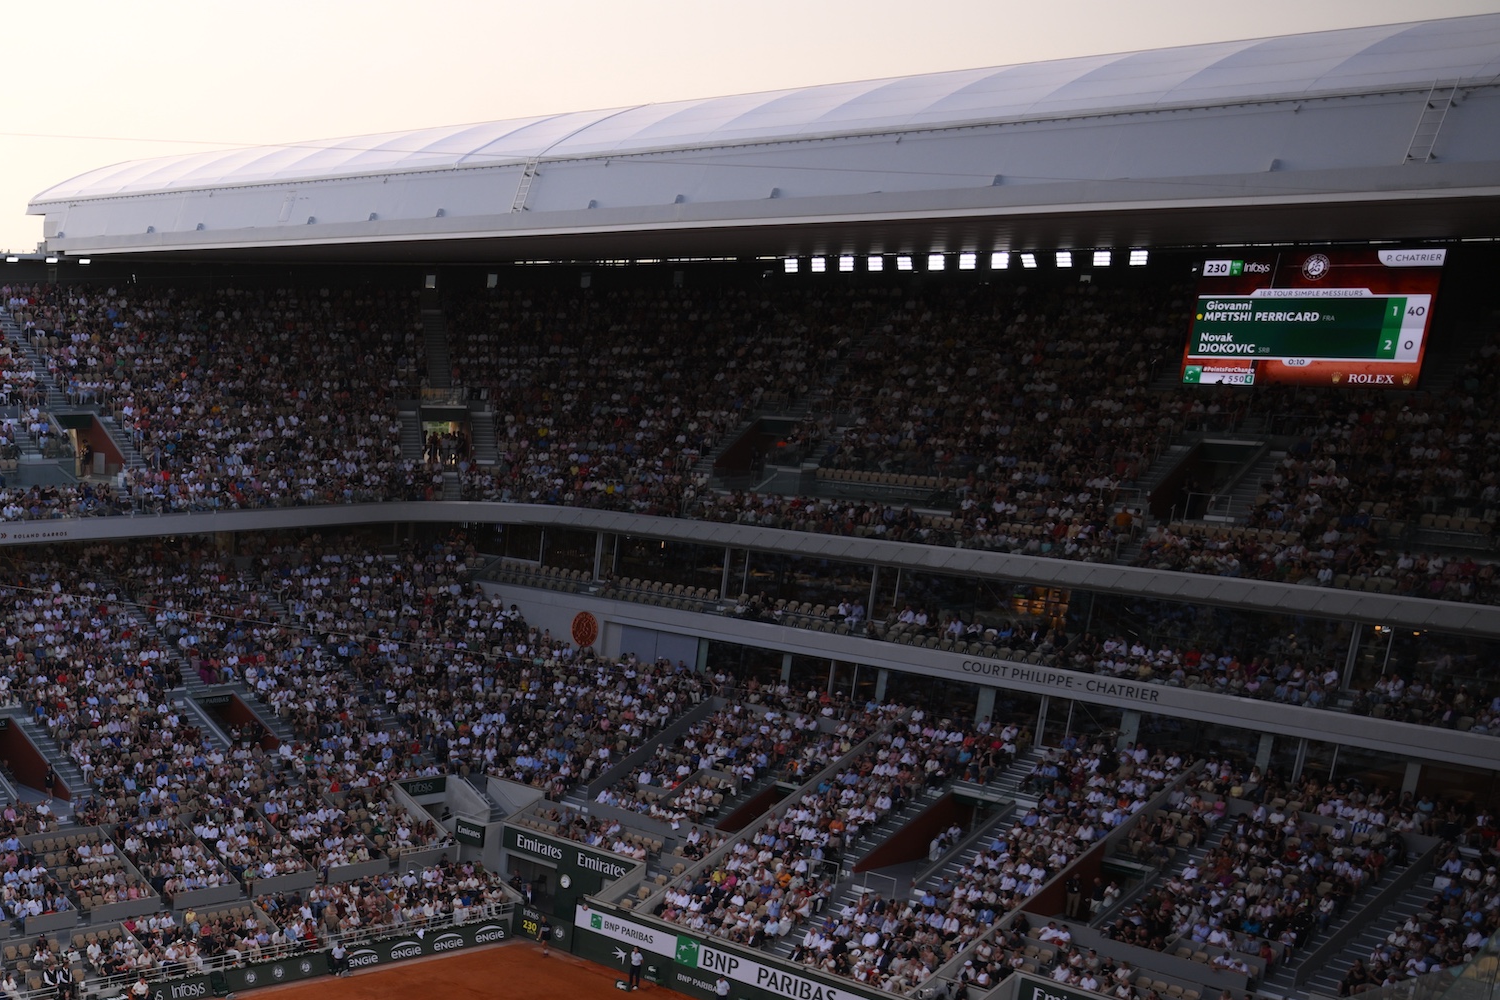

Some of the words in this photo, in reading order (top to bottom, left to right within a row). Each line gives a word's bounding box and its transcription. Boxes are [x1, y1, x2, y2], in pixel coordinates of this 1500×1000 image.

[1396, 253, 1442, 262] CHATRIER
[1207, 264, 1228, 273] 230
[1244, 262, 1271, 274] Infosys
[1206, 301, 1253, 310] Giovanni
[1393, 306, 1398, 316] 1
[1407, 306, 1426, 316] 40
[1204, 312, 1252, 321] MPETSHI
[1255, 312, 1320, 322] PERRICARD
[1200, 333, 1234, 342] Novak
[1198, 344, 1256, 354] DJOKOVIC
[1383, 340, 1392, 350] 2
[1404, 340, 1414, 350] 0
[1203, 366, 1255, 374] #PointsForChange
[1348, 374, 1395, 384] ROLEX
[962, 660, 1009, 678] COURT
[1011, 668, 1074, 688] PHILIPPE
[1086, 680, 1160, 702] CHATRIER
[408, 782, 433, 793] Infosys
[516, 834, 563, 860] Emirates
[577, 852, 627, 878] Emirates
[523, 919, 538, 933] 230
[604, 921, 620, 933] BNP
[622, 927, 654, 945] PARIBAS
[703, 950, 740, 975] BNP
[677, 973, 692, 984] BNP
[692, 978, 718, 993] PARIBA
[171, 982, 206, 999] Infosys
